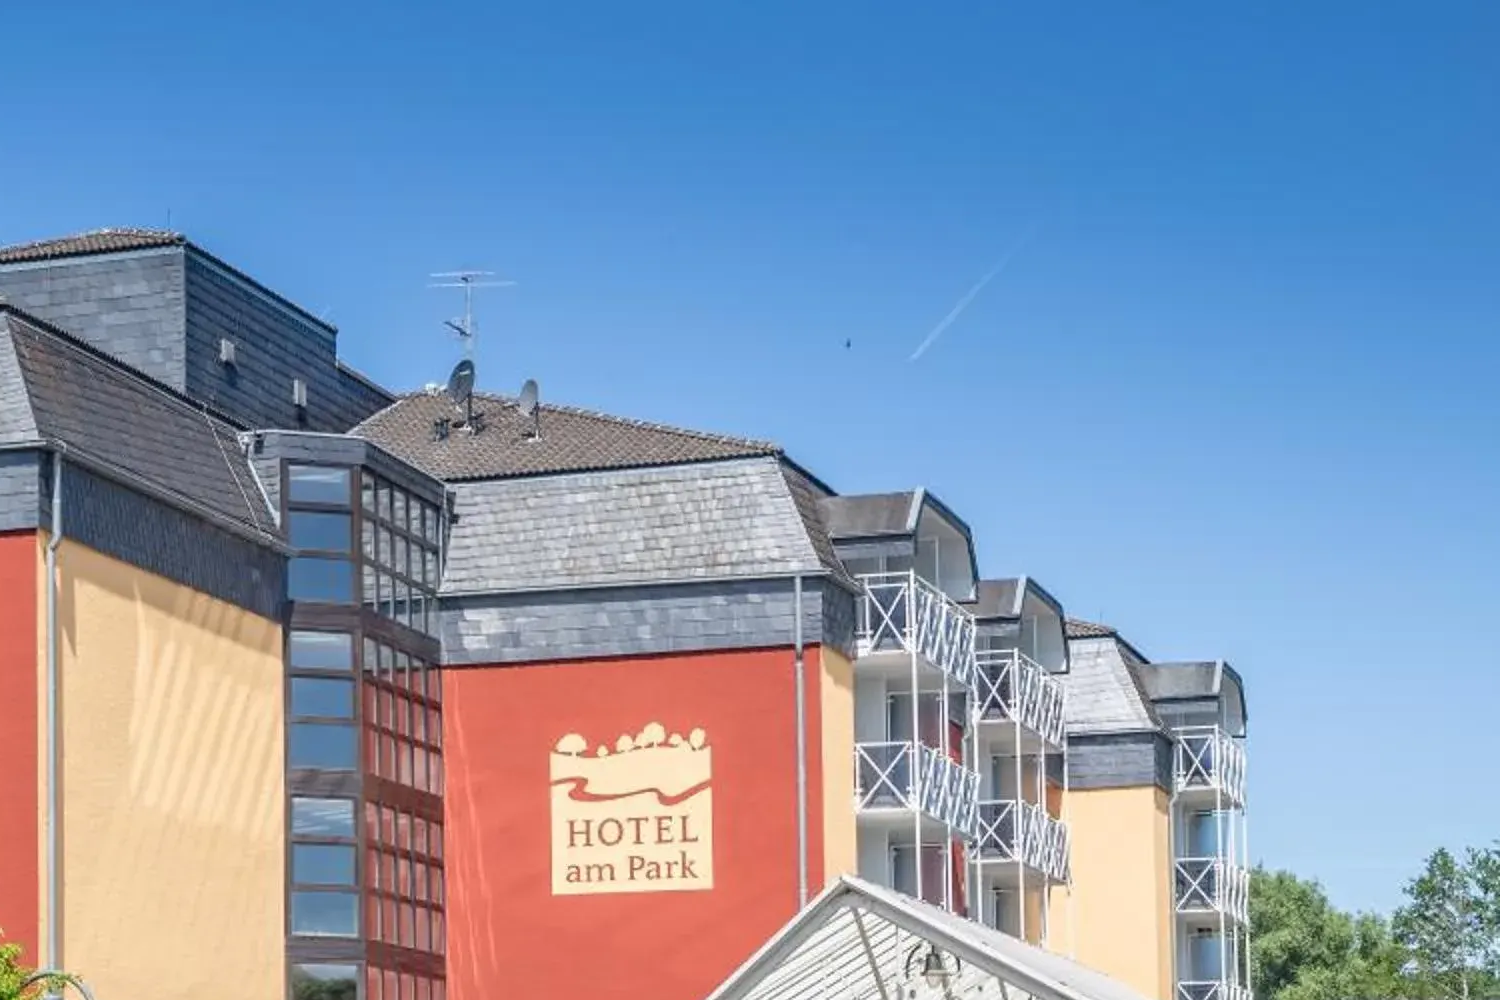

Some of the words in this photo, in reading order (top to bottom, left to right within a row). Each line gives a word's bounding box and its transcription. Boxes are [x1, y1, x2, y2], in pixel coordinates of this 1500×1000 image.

[567, 815, 699, 848] HOTEL
[566, 863, 616, 883] am
[628, 850, 698, 881] Park
